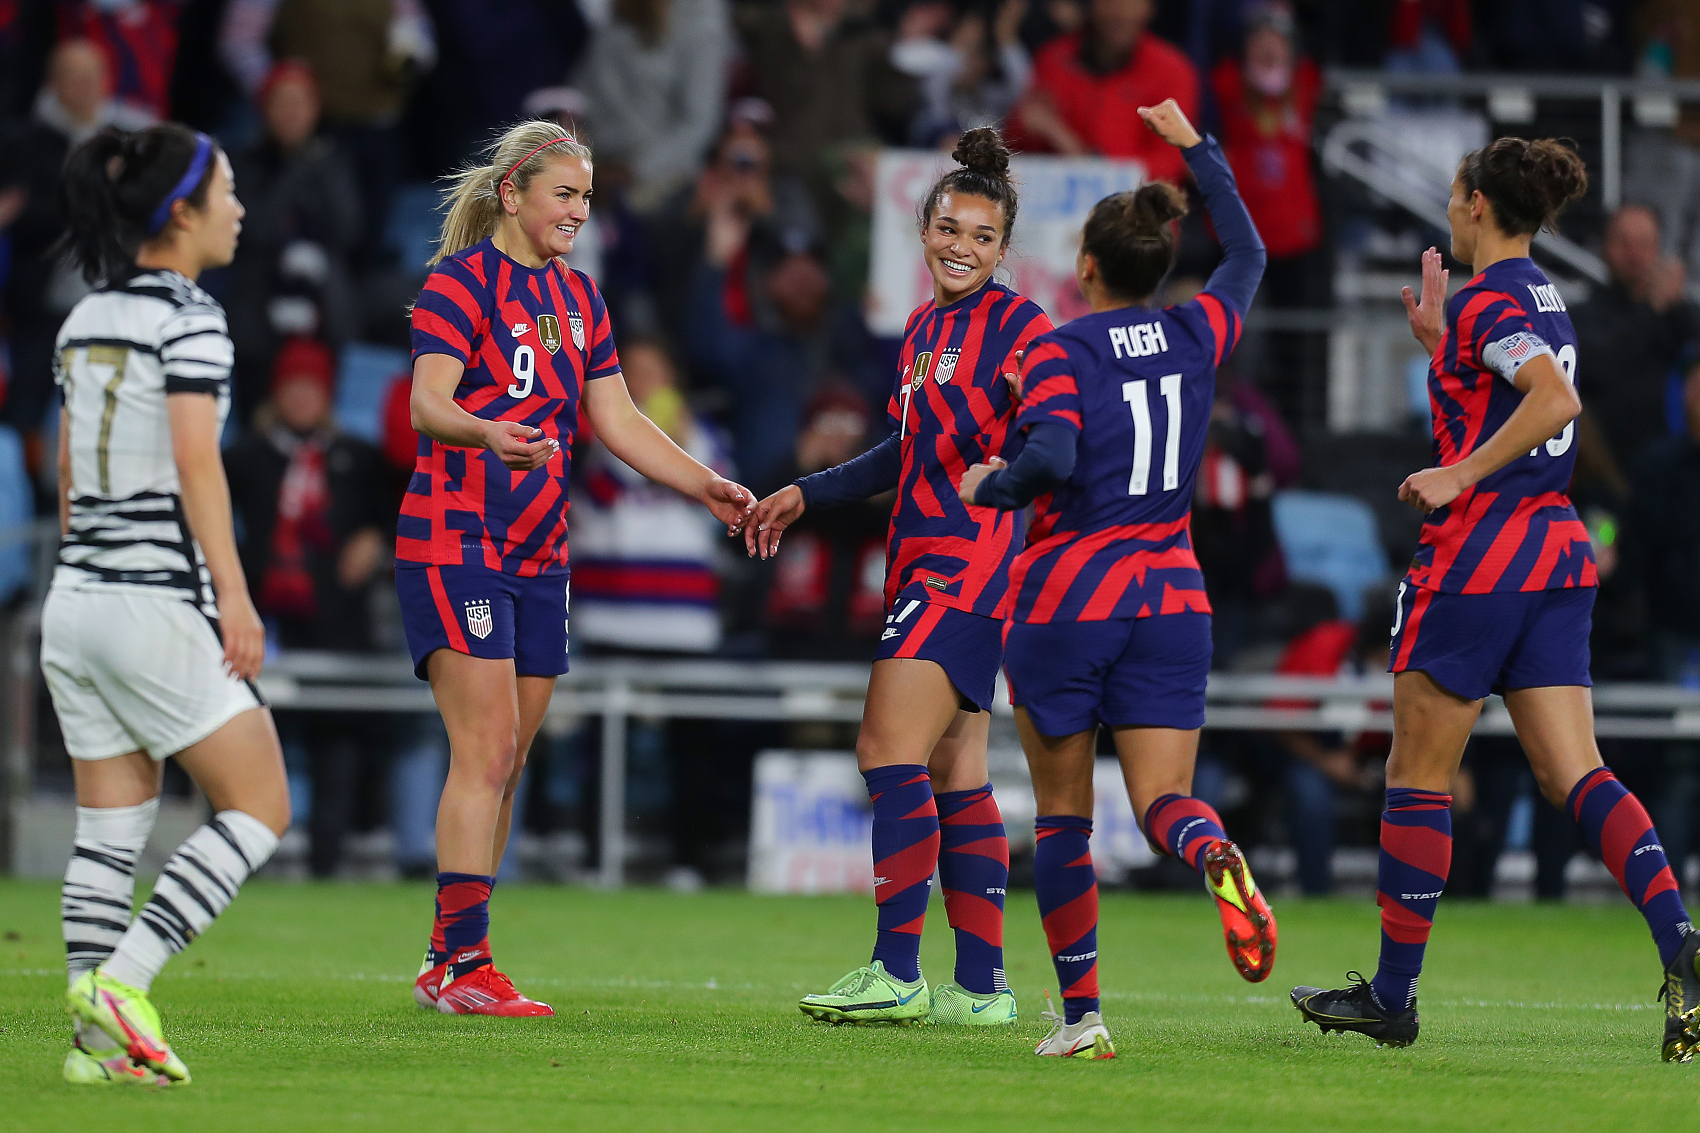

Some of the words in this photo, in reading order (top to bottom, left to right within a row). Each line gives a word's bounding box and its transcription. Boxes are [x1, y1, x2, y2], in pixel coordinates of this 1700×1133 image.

[1108, 321, 1169, 359] PUGH
[1500, 335, 1521, 350] USA
[508, 345, 535, 398] 9
[941, 355, 957, 366] USA
[900, 383, 911, 440] 7
[1122, 373, 1182, 495] 11
[468, 607, 489, 620] USA
